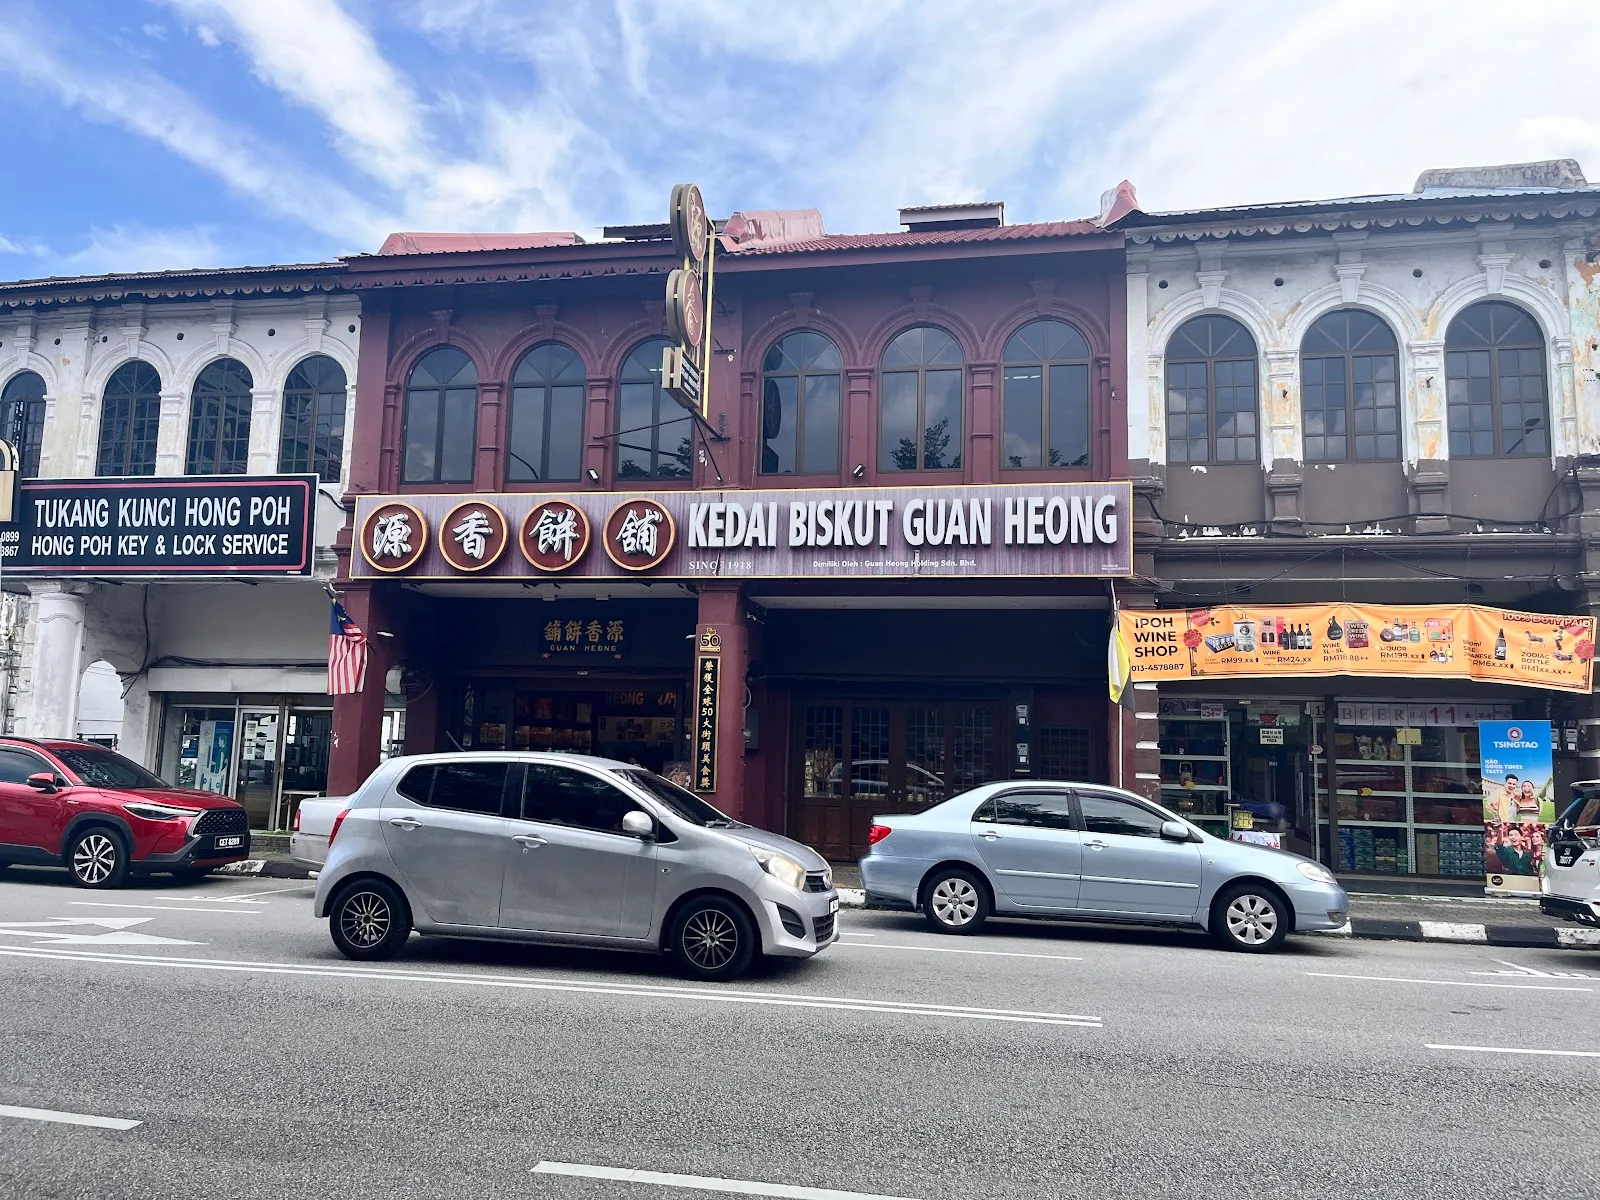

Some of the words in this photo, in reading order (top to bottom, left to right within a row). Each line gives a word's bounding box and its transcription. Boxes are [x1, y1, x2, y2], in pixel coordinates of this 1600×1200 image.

[35, 498, 109, 527] TUKANG
[118, 497, 176, 527] KUNCI
[185, 496, 241, 526] HONG
[249, 496, 291, 526] POH
[688, 502, 777, 547] KEDAI
[789, 500, 894, 546] BISKUT
[902, 498, 992, 546] GUAN
[1004, 495, 1118, 544] HEONG
[31, 535, 74, 556] HONG
[80, 535, 112, 555] POH
[118, 534, 148, 555] KEY
[155, 535, 166, 555] &
[173, 534, 216, 555] LOCK
[222, 533, 289, 555] SERVICE
[689, 561, 725, 570] SINCE
[728, 561, 752, 570] 1918
[885, 560, 909, 568] Heong
[911, 559, 939, 568] Holding
[941, 559, 958, 567] Sdn.
[960, 559, 977, 567] Bhd.
[1135, 617, 1173, 629] IPOH
[1503, 612, 1531, 622] 100%
[1532, 616, 1563, 626] DUTY
[1564, 619, 1591, 628] PAID
[700, 634, 721, 647] 50
[1134, 631, 1177, 643] WINE
[1134, 645, 1178, 658] SHOP
[1215, 642, 1233, 651] BEER
[1521, 651, 1550, 660] ZODIAC
[1521, 657, 1550, 666] BOTTLE
[1341, 707, 1405, 721] BEER
[1493, 741, 1538, 749] TSINGTAO
